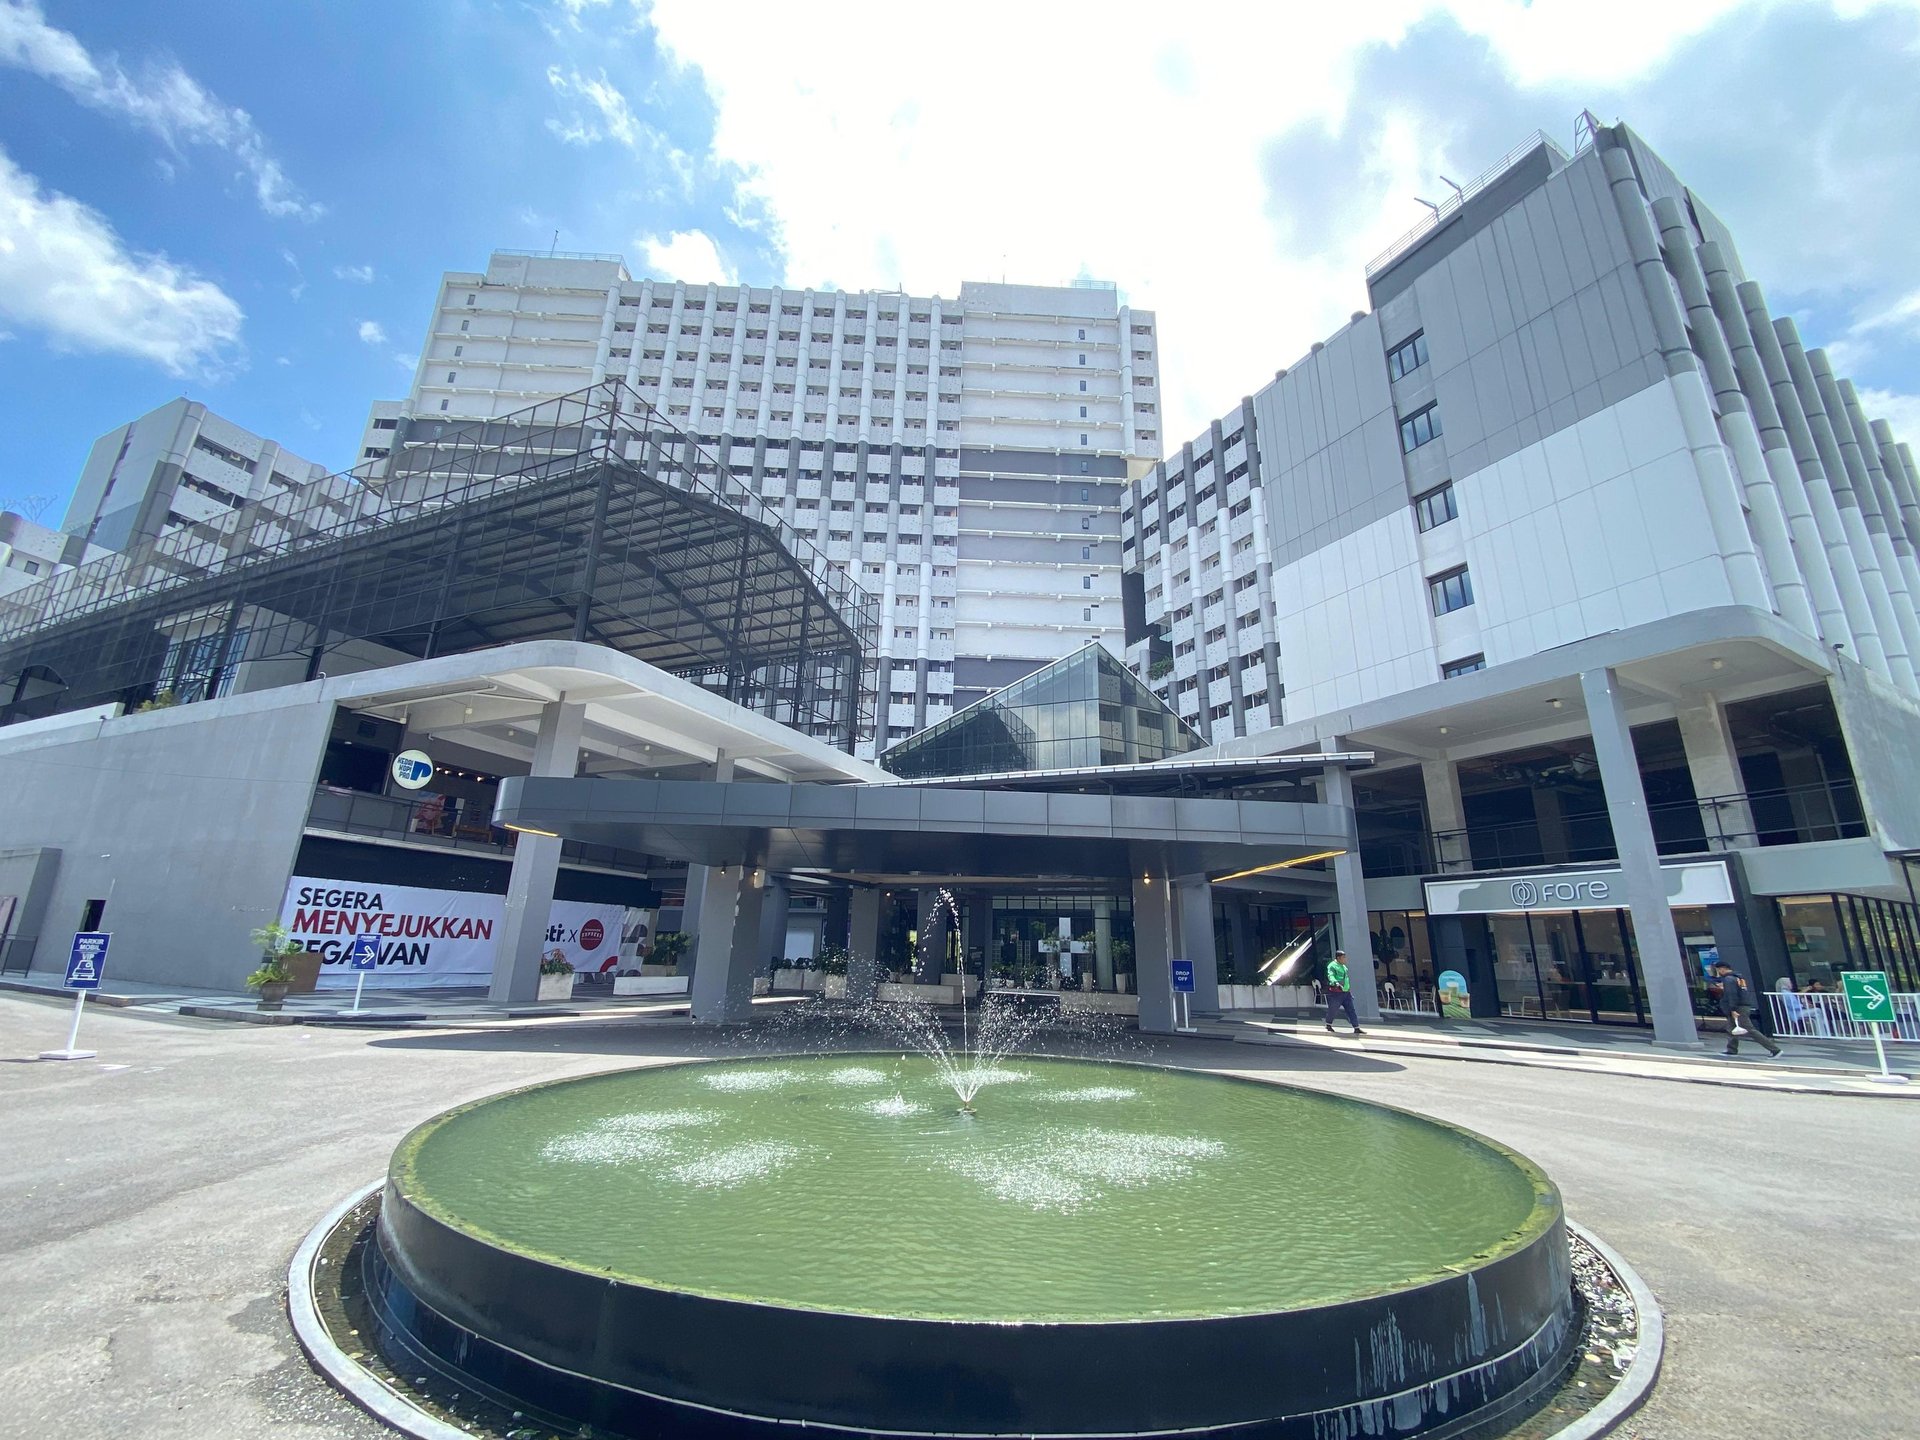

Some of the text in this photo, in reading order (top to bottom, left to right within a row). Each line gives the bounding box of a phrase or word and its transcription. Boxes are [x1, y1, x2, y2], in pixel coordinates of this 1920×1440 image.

[398, 764, 412, 772] KOPI
[398, 771, 410, 779] PRO
[297, 887, 383, 910] SEGERA
[292, 908, 493, 940] MENYEJUKKAN
